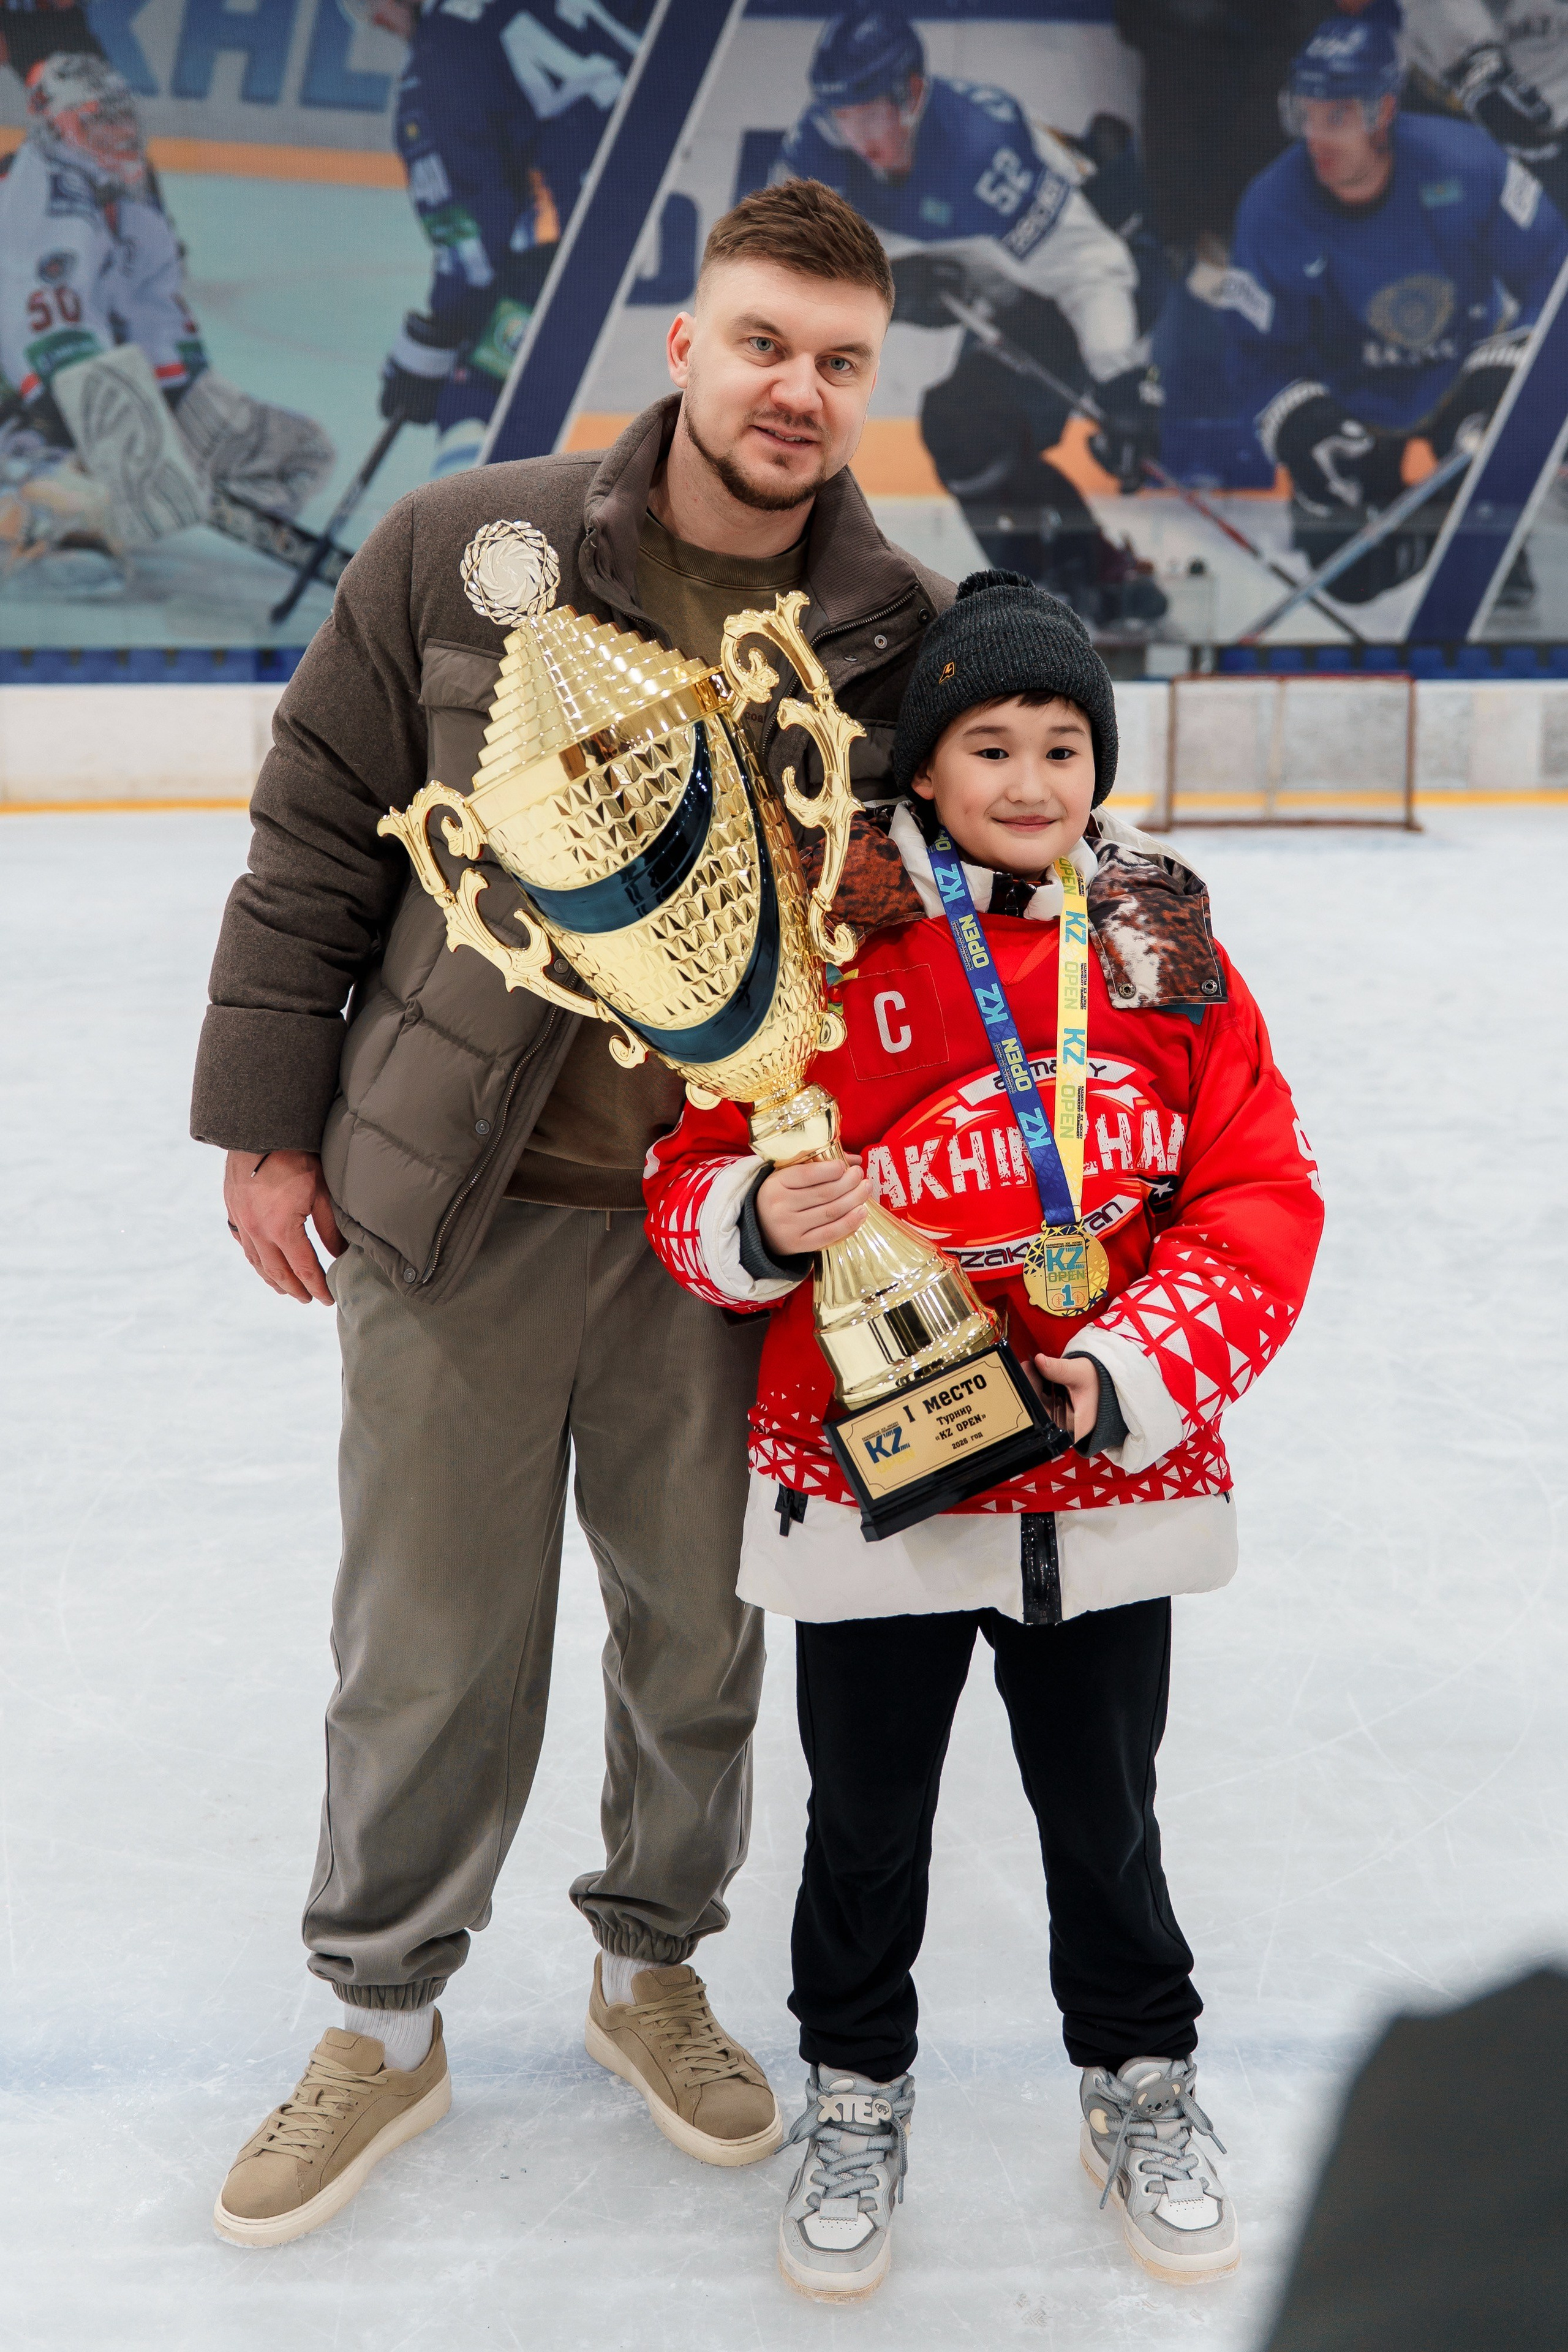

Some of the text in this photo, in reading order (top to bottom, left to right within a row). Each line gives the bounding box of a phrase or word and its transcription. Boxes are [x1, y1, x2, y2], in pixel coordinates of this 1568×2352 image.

[974, 147, 1035, 217] 52
[26, 283, 82, 331] 50
[934, 863, 966, 903] KZ
[1059, 858, 1077, 895] OPEN
[959, 913, 990, 968] OPEN
[1065, 910, 1087, 945] KZ
[974, 982, 1009, 1025] KZ
[1064, 961, 1079, 1010] OPEN
[873, 990, 912, 1054] C
[1001, 1037, 1033, 1092] OPEN
[1063, 1028, 1085, 1065] KZ
[1017, 1107, 1052, 1149] KZ
[1060, 1084, 1076, 1139] OPEN
[1046, 1246, 1085, 1272] KZ
[1048, 1270, 1086, 1283] OPEN
[1061, 1284, 1075, 1307] 1
[902, 1404, 916, 1423] I
[936, 1404, 973, 1425] Турнир
[956, 1414, 987, 1432] OPEN»
[864, 1426, 911, 1464] KZ
[970, 1431, 984, 1441] год
[817, 2094, 892, 2126] XTEP
